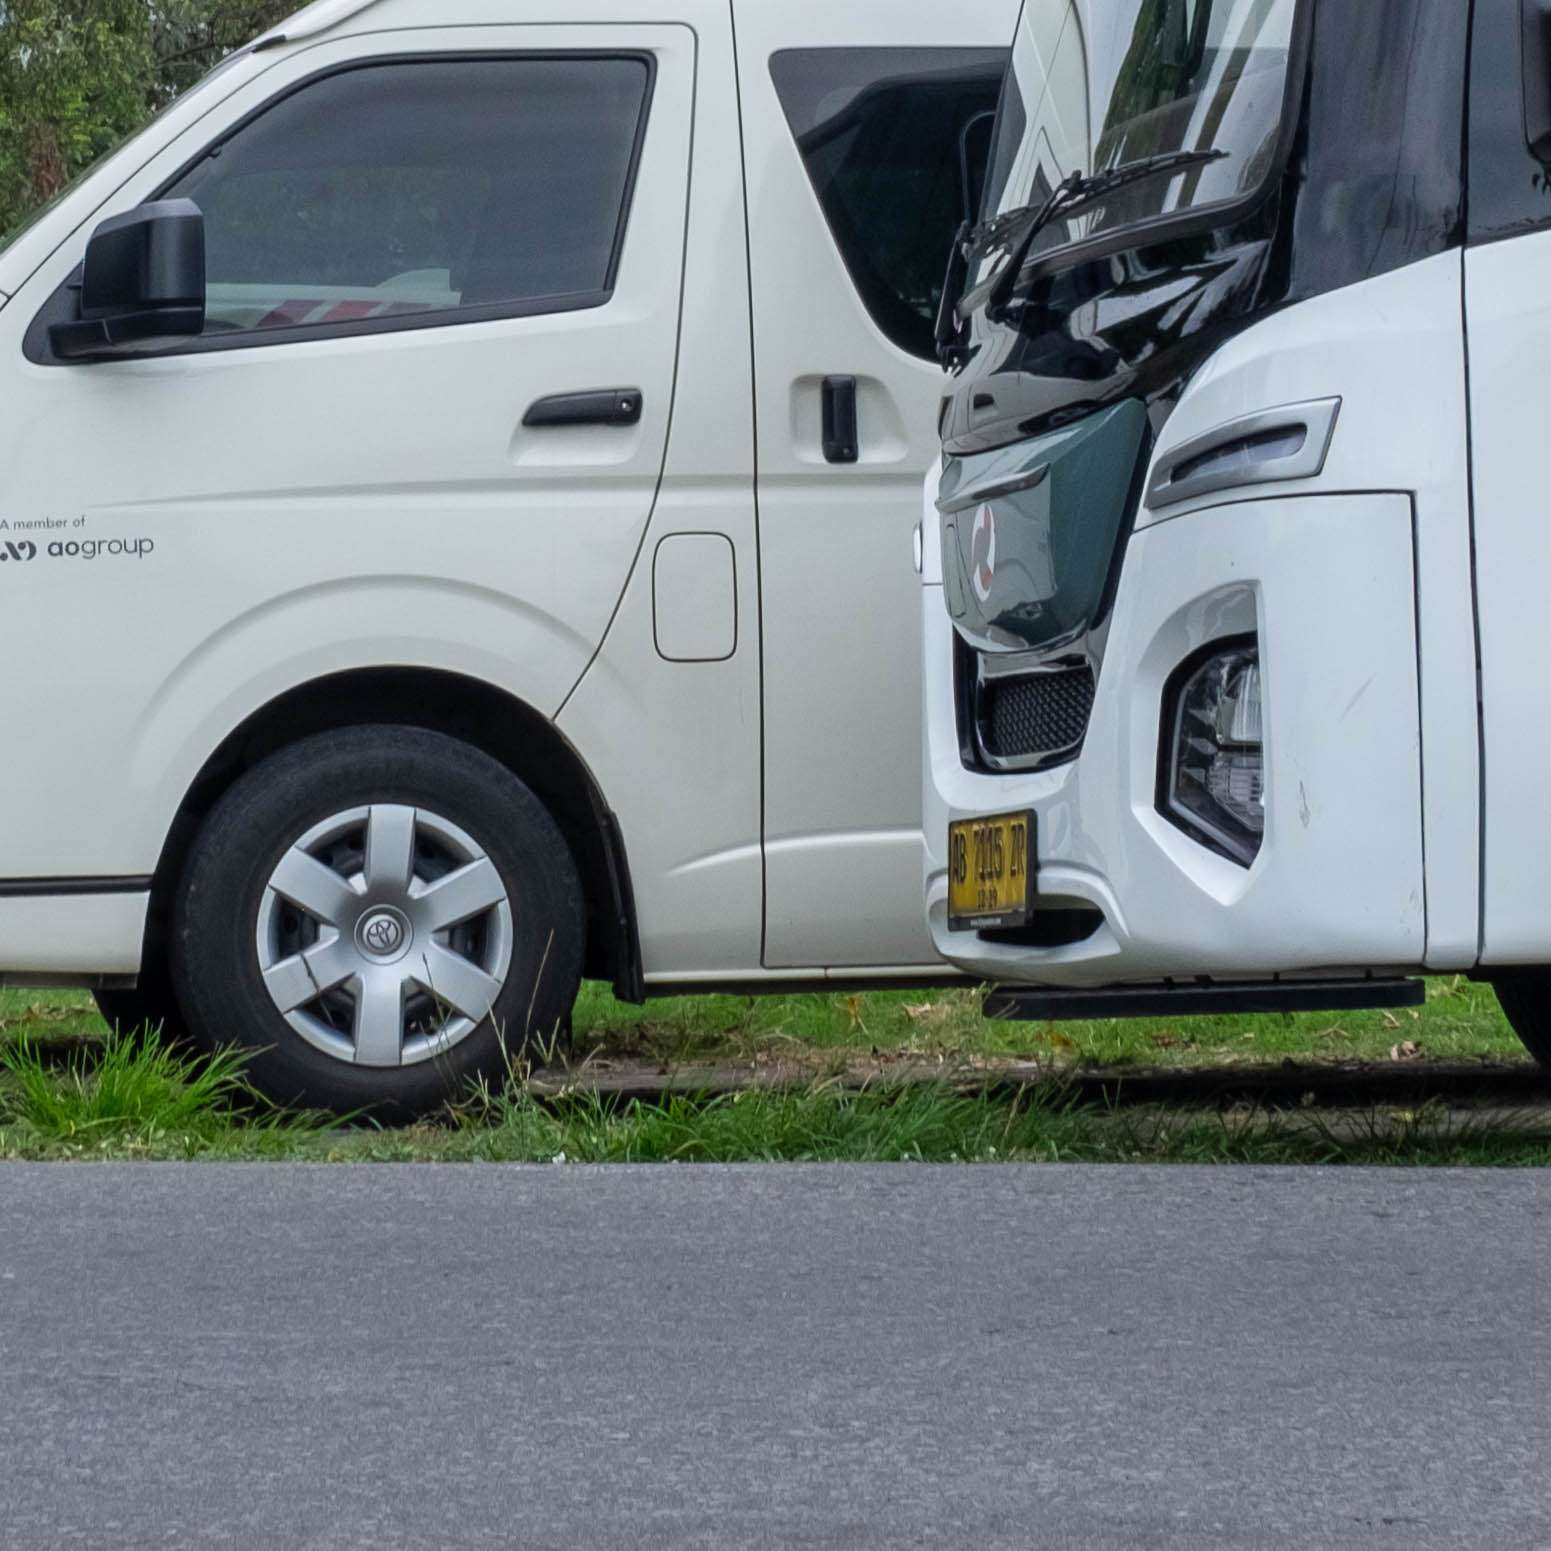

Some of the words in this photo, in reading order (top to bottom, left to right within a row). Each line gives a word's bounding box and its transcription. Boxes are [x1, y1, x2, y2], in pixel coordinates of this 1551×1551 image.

[0, 519, 10, 531] A
[13, 516, 68, 530] member
[72, 514, 87, 528] of
[47, 536, 155, 559] aogroup
